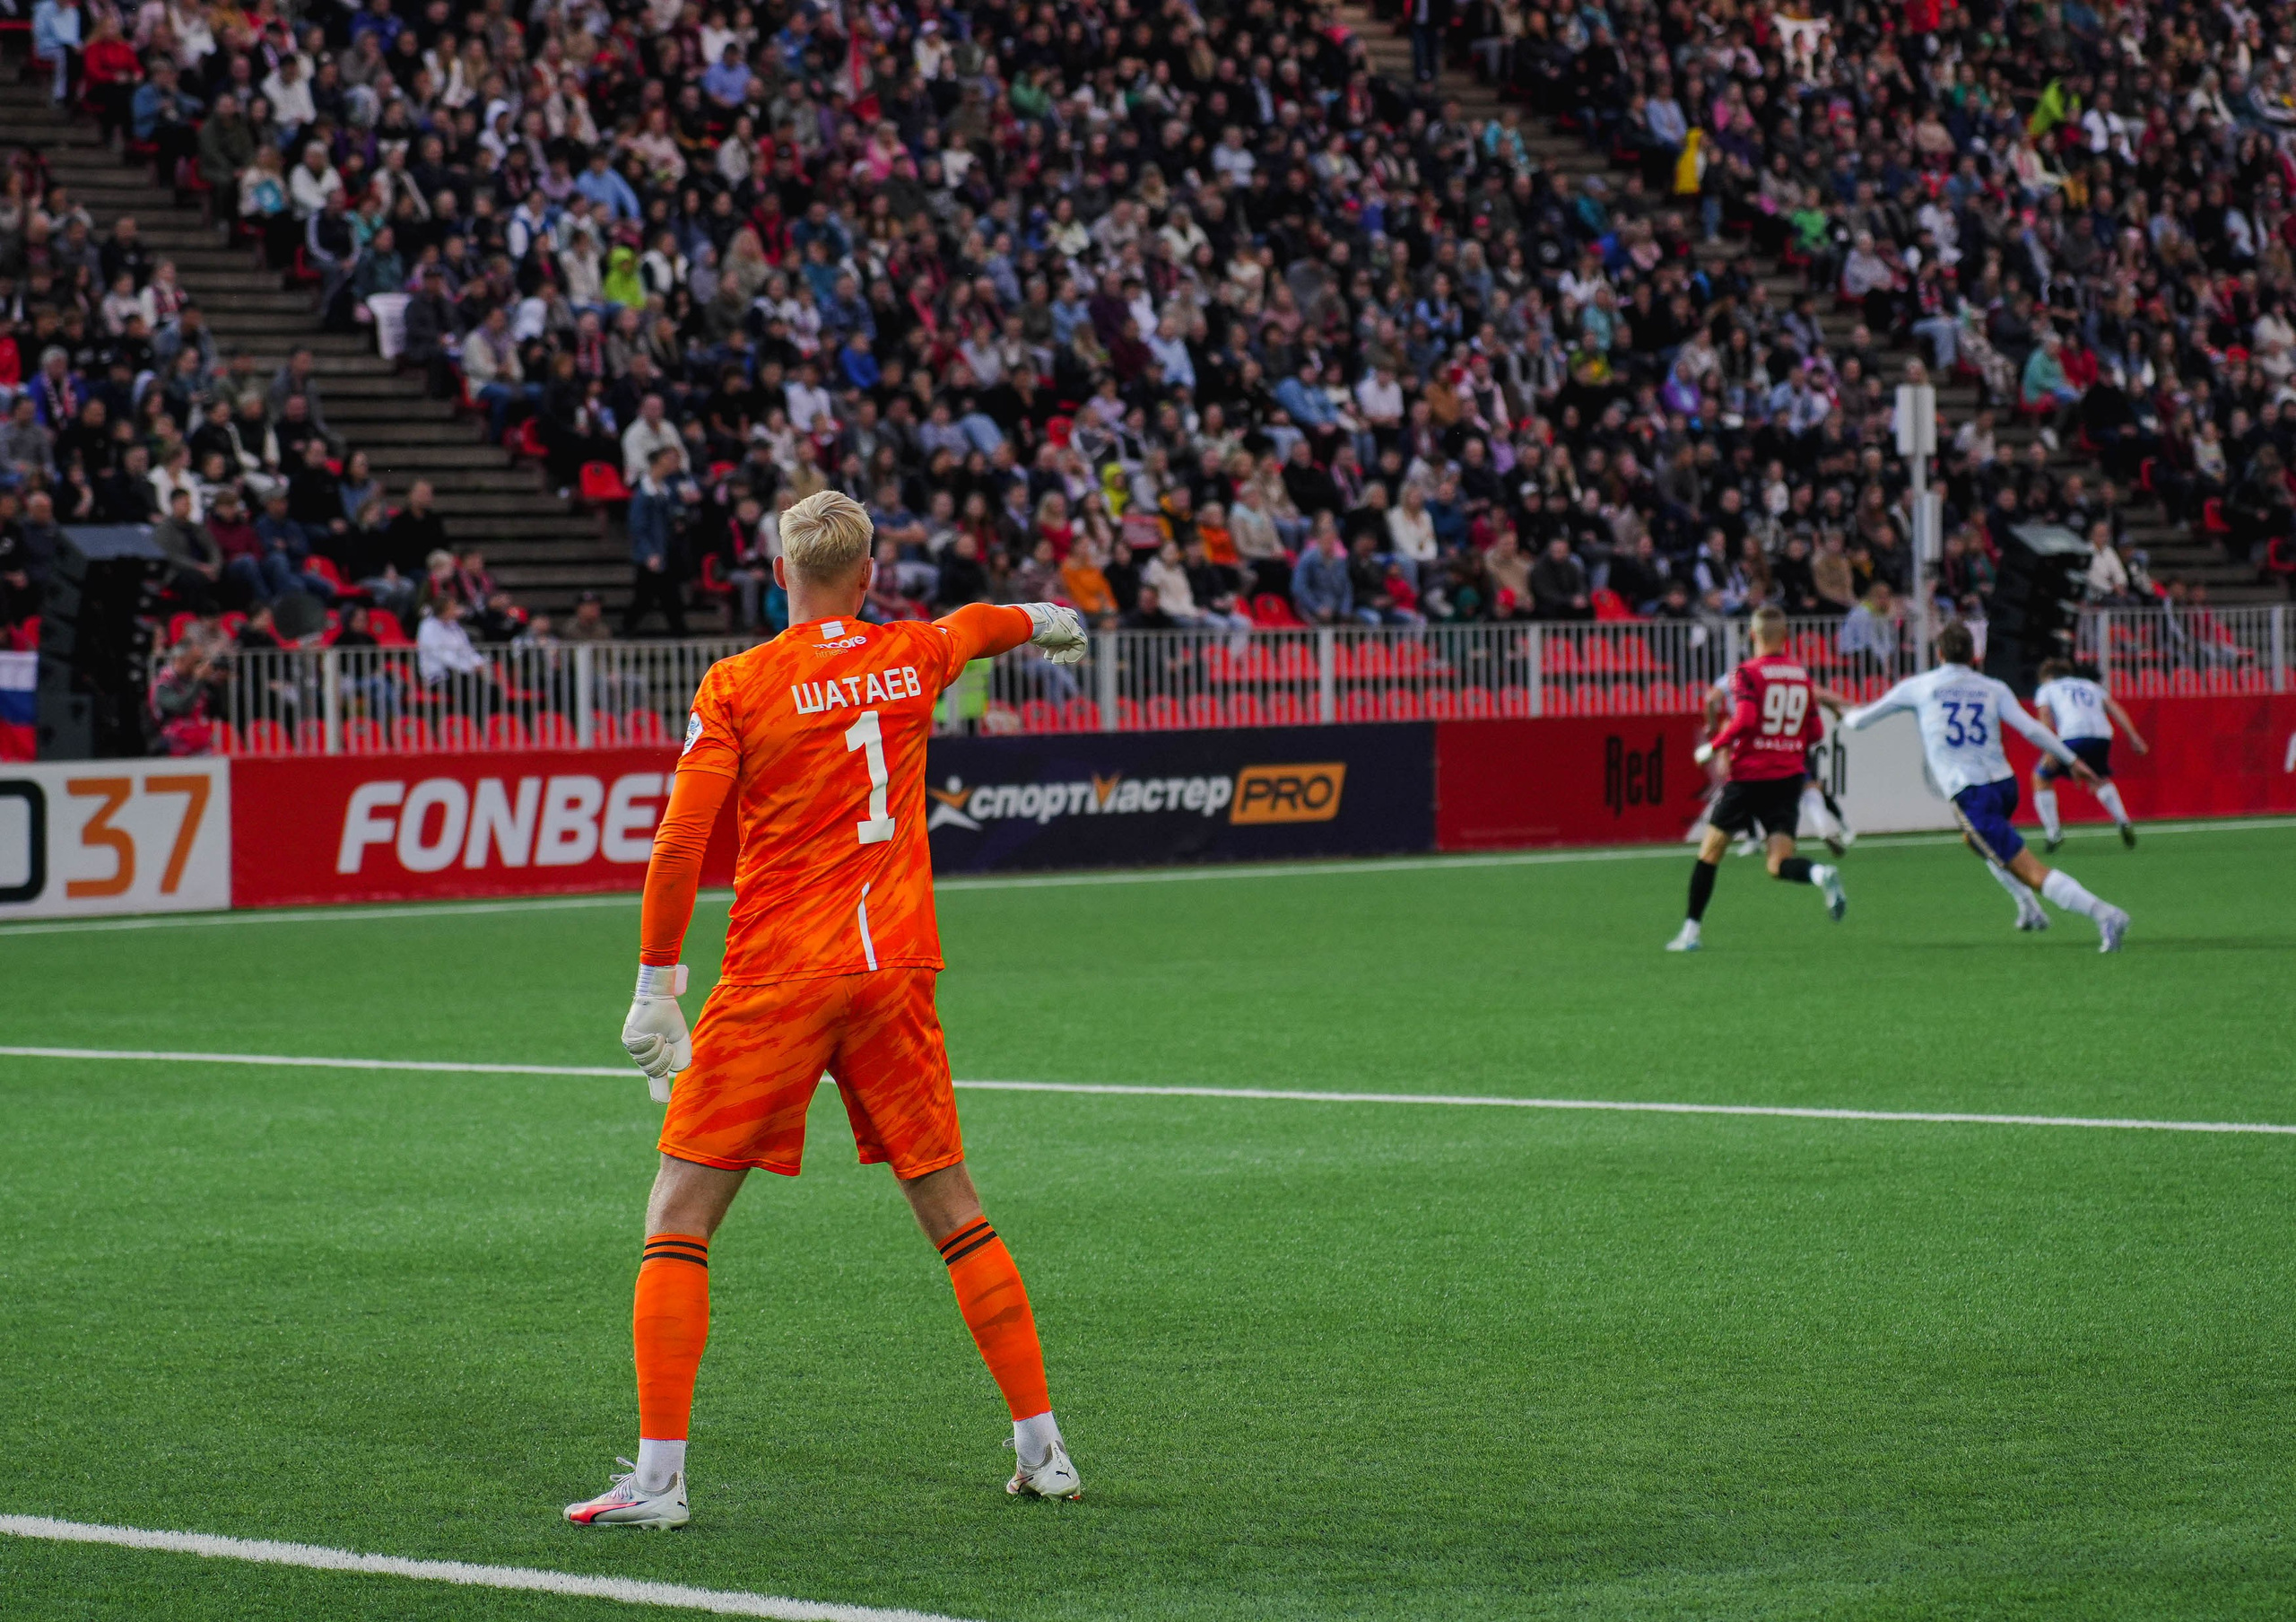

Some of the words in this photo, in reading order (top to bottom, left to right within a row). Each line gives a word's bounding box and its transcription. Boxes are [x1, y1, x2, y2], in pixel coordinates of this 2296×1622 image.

[814, 647, 849, 659] fitness
[791, 666, 922, 715] ШАТАЕВ
[1761, 683, 1809, 737] 99
[1942, 701, 1987, 747] 33
[845, 710, 895, 844] 1
[1240, 773, 1334, 814] PRO
[1605, 732, 1665, 819] Red
[336, 772, 674, 874] FONBE
